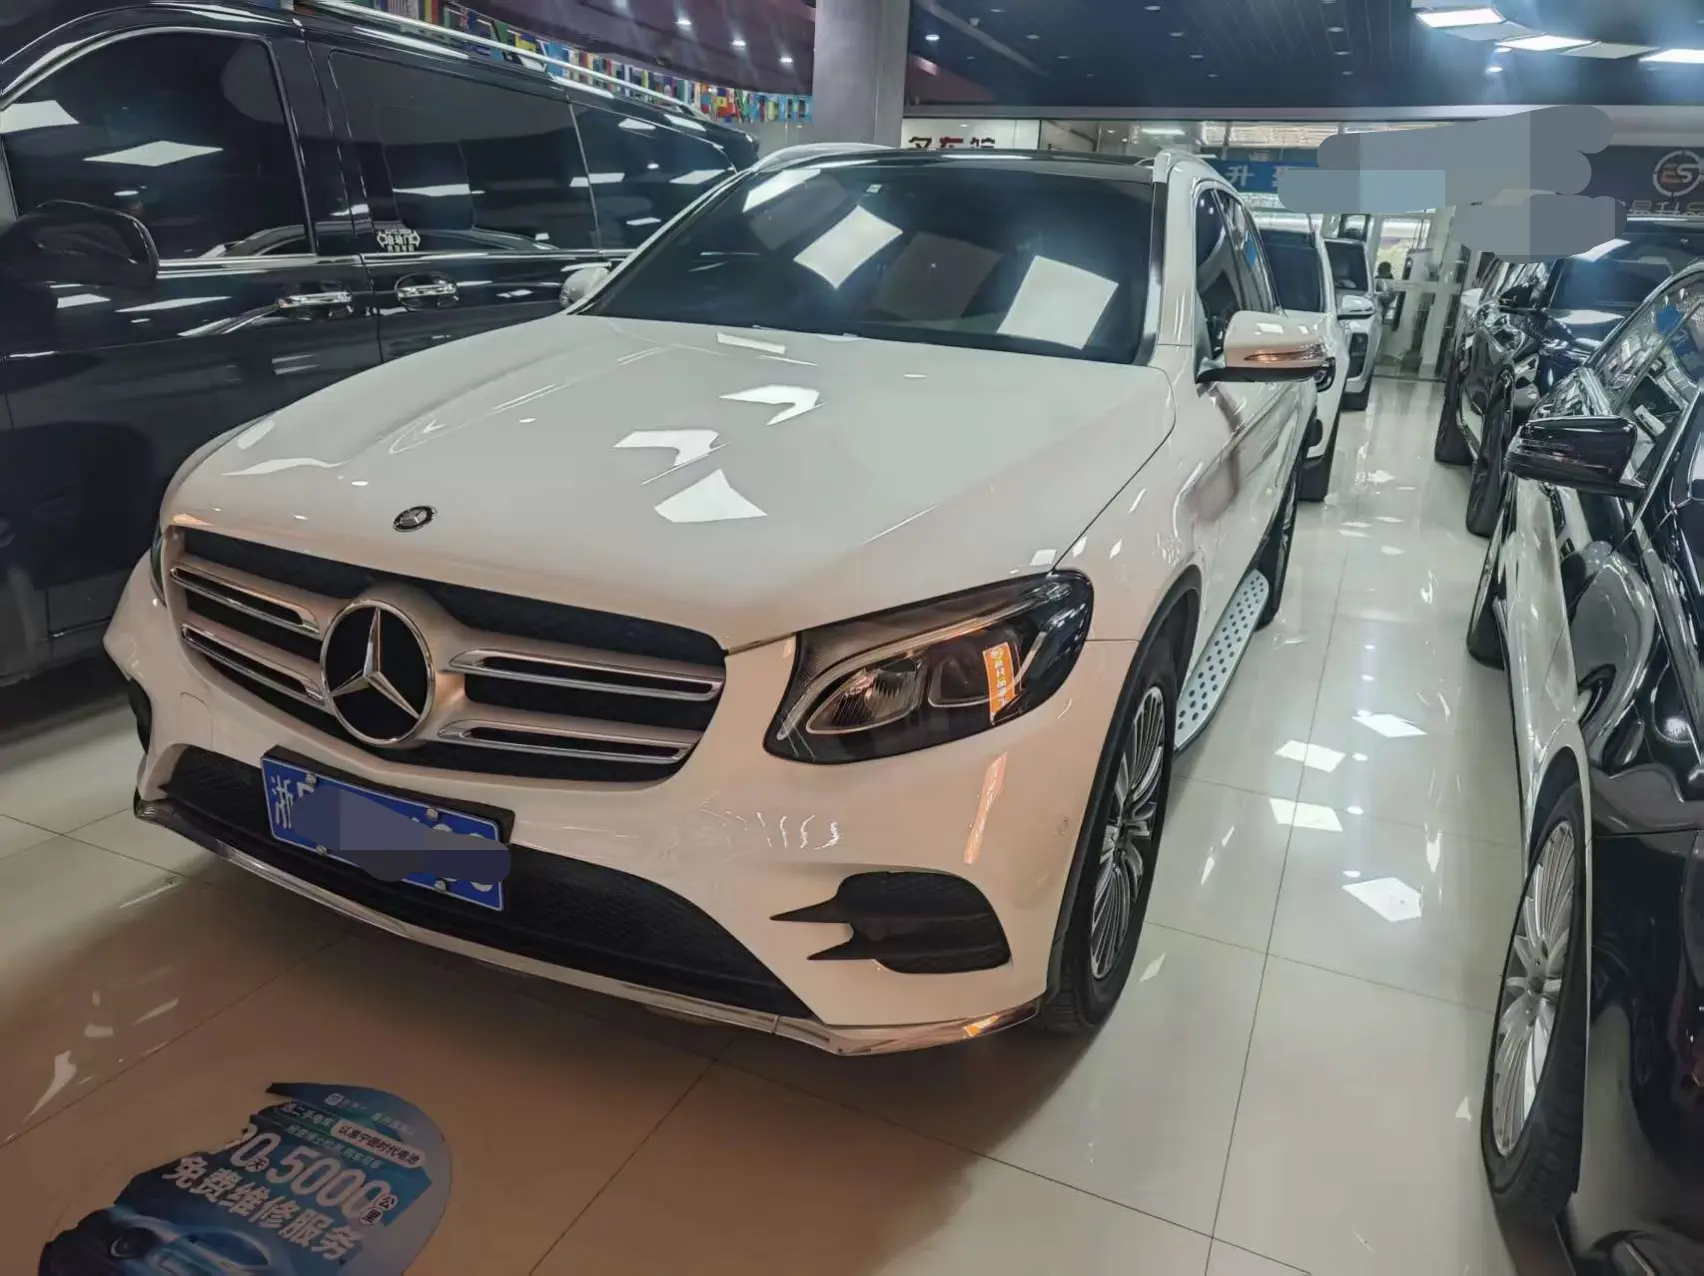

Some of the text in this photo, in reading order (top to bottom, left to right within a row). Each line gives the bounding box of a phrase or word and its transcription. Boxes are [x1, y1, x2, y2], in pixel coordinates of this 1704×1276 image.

[162, 1155, 364, 1261] 免费维修服务
